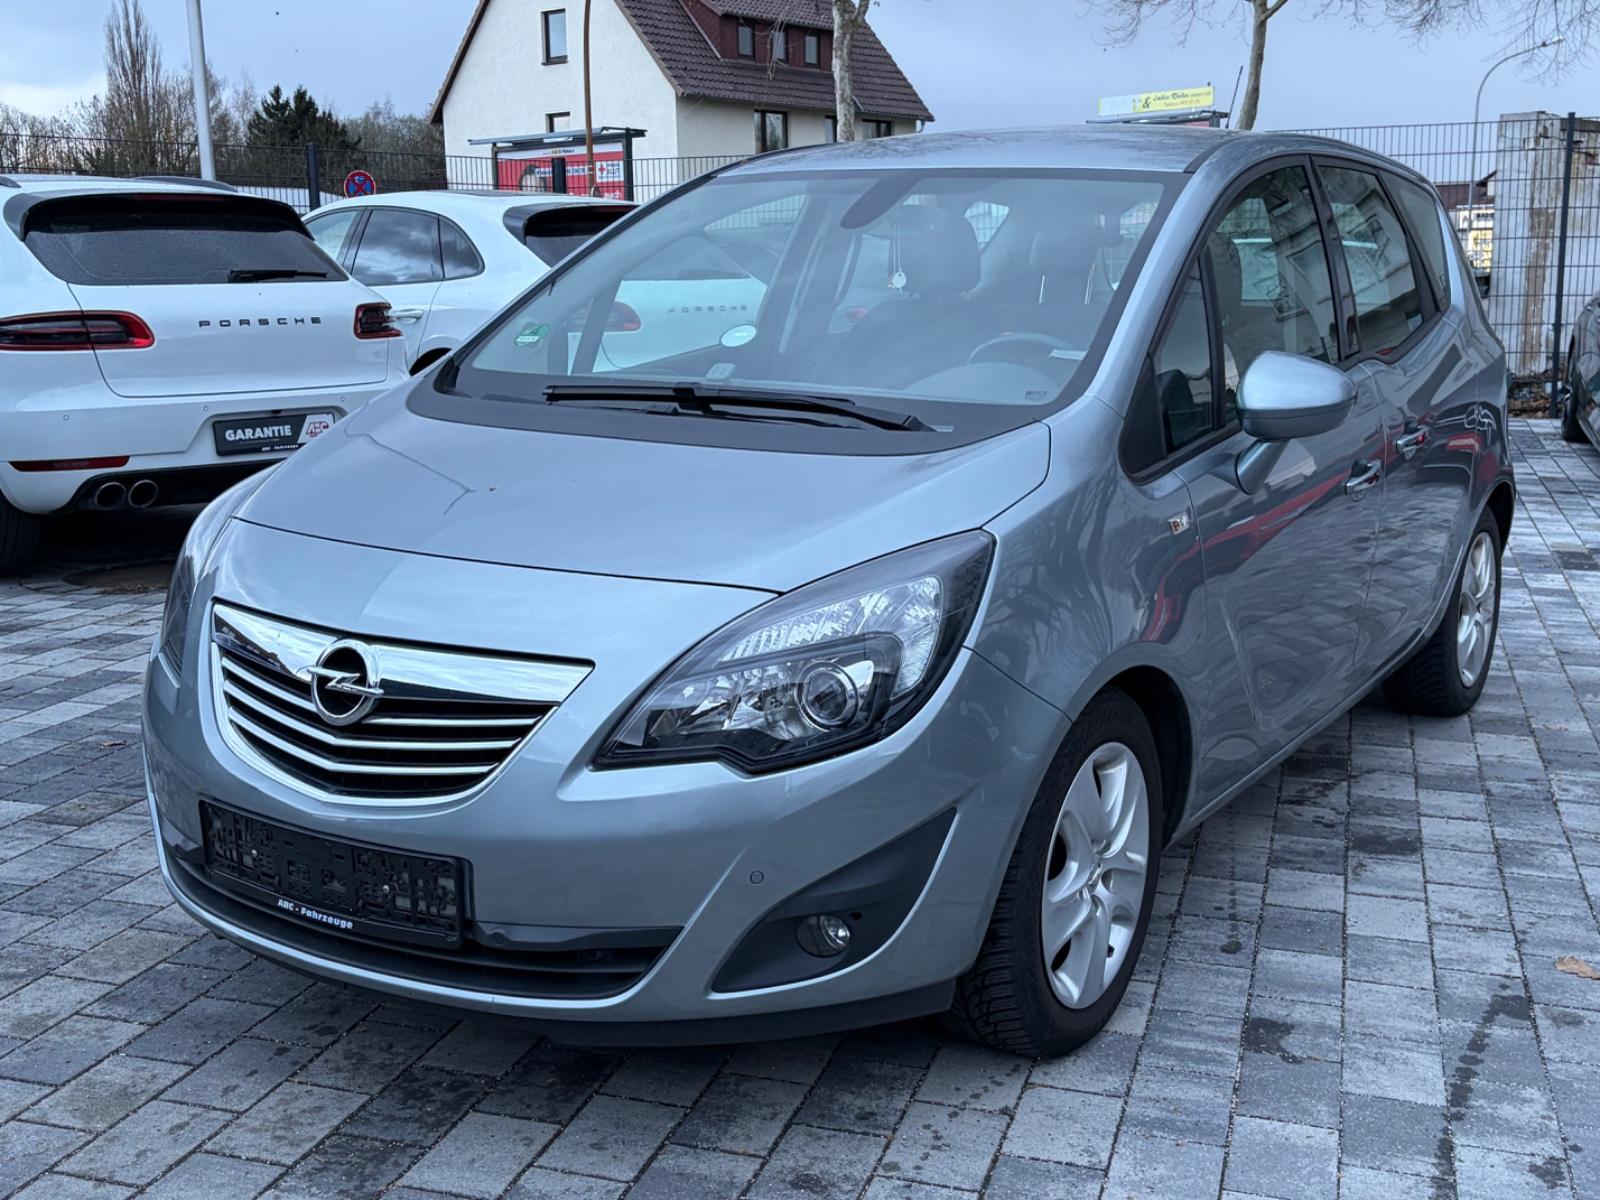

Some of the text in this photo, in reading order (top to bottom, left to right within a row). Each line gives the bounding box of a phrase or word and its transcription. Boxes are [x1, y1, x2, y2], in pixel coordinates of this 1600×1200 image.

[199, 316, 322, 328] PORSCHE
[224, 425, 293, 441] GARANTIE
[277, 899, 295, 911] ABC
[301, 907, 354, 930] Fahrzeuge
